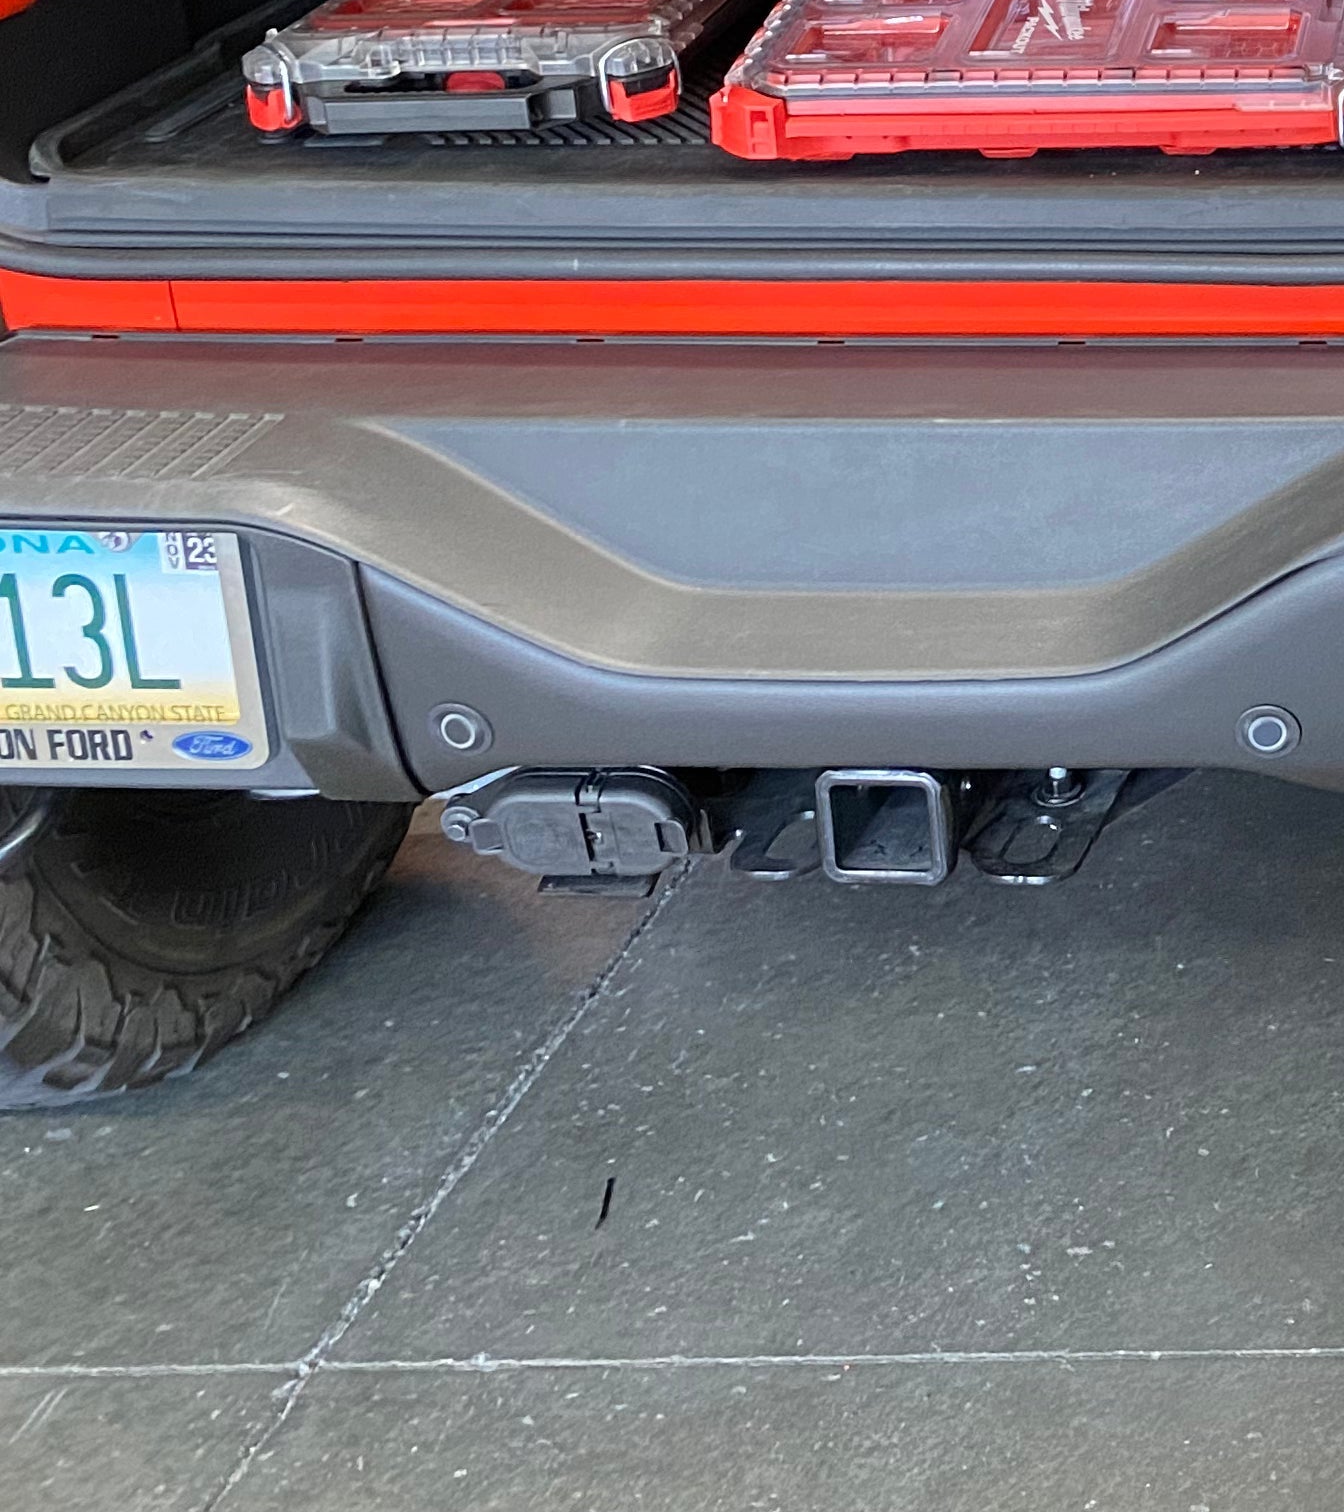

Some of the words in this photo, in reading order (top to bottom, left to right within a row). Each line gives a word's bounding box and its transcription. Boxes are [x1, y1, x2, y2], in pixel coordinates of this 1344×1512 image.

[0, 534, 95, 554] NA
[186, 537, 218, 564] 23
[0, 573, 181, 689] 13L
[5, 704, 76, 721] GRAND
[81, 704, 165, 721] CANYON
[171, 705, 225, 722] STATE
[46, 729, 133, 761] FORD
[188, 737, 236, 755] Ford
